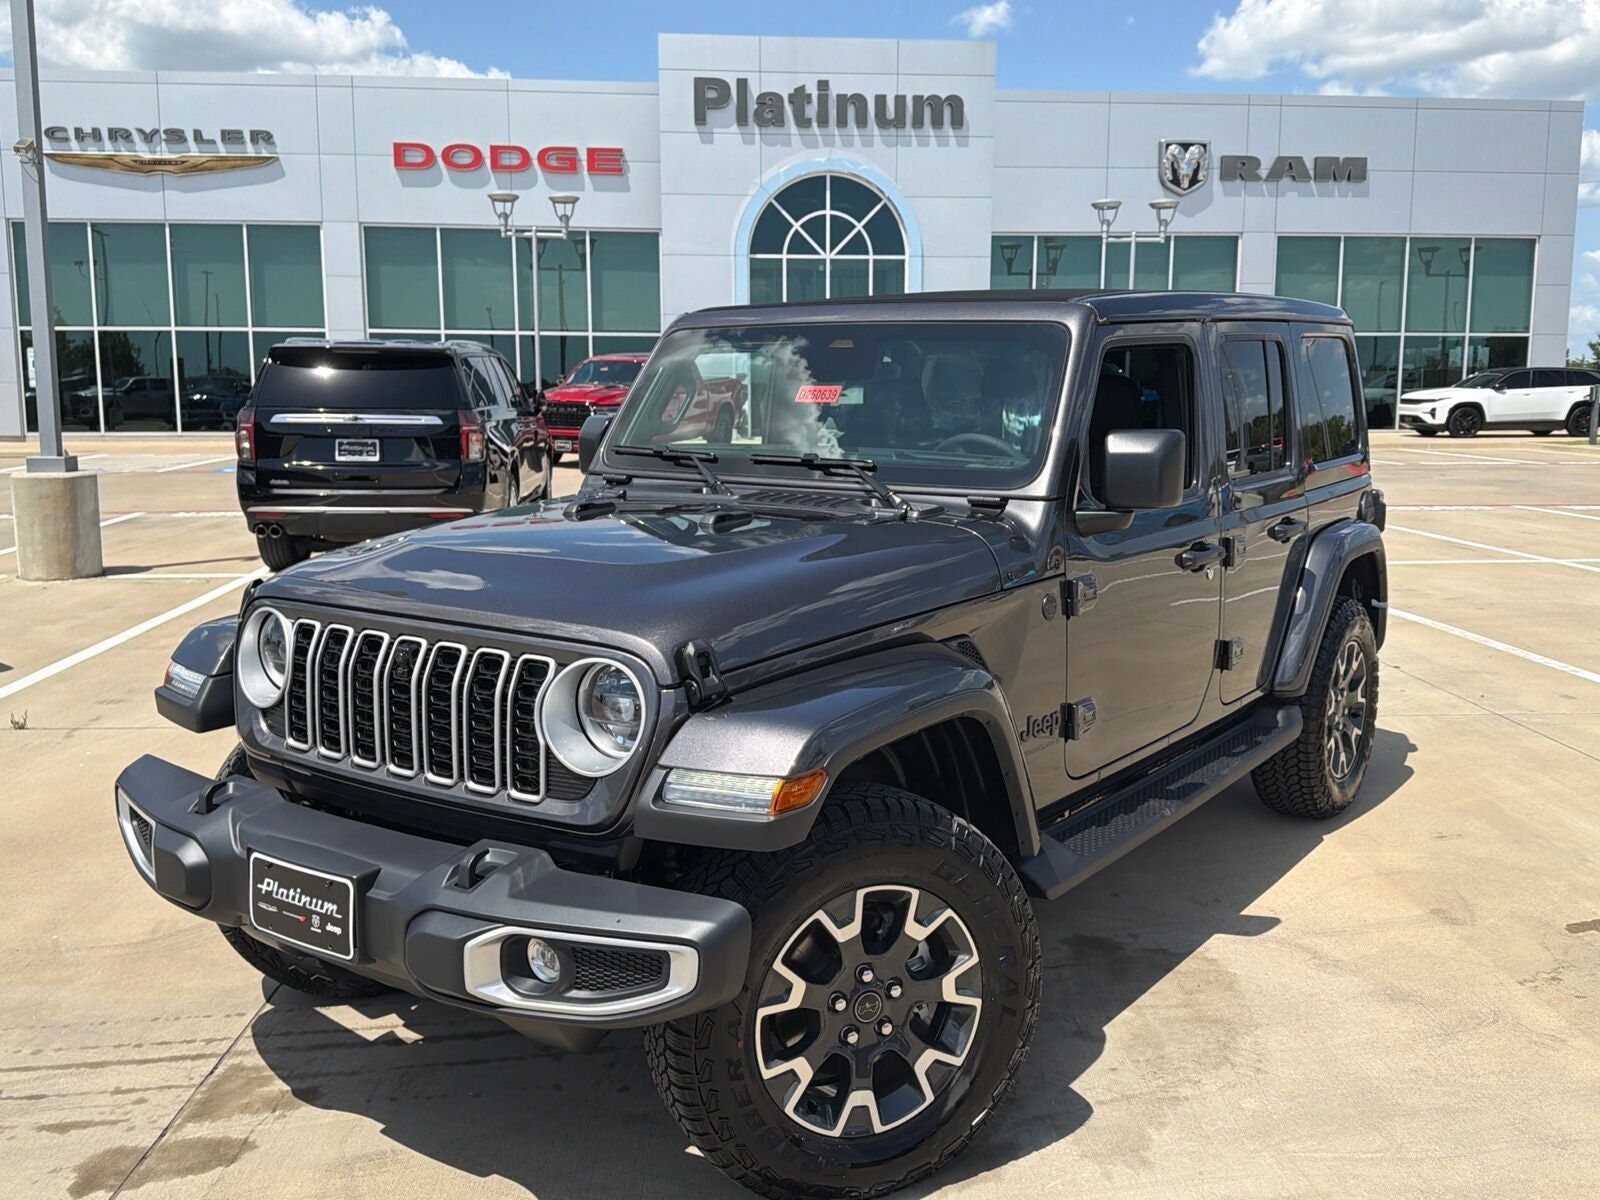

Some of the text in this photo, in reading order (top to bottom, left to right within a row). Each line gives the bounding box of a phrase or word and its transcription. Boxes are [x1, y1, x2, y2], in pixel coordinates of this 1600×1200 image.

[693, 76, 966, 129] Platinum
[43, 125, 275, 146] CHRYSLER
[392, 142, 625, 176] DODGE
[1219, 154, 1369, 183] RAM
[1020, 709, 1060, 743] Jeep
[256, 877, 343, 919] Platinum
[325, 921, 342, 936] Jeep
